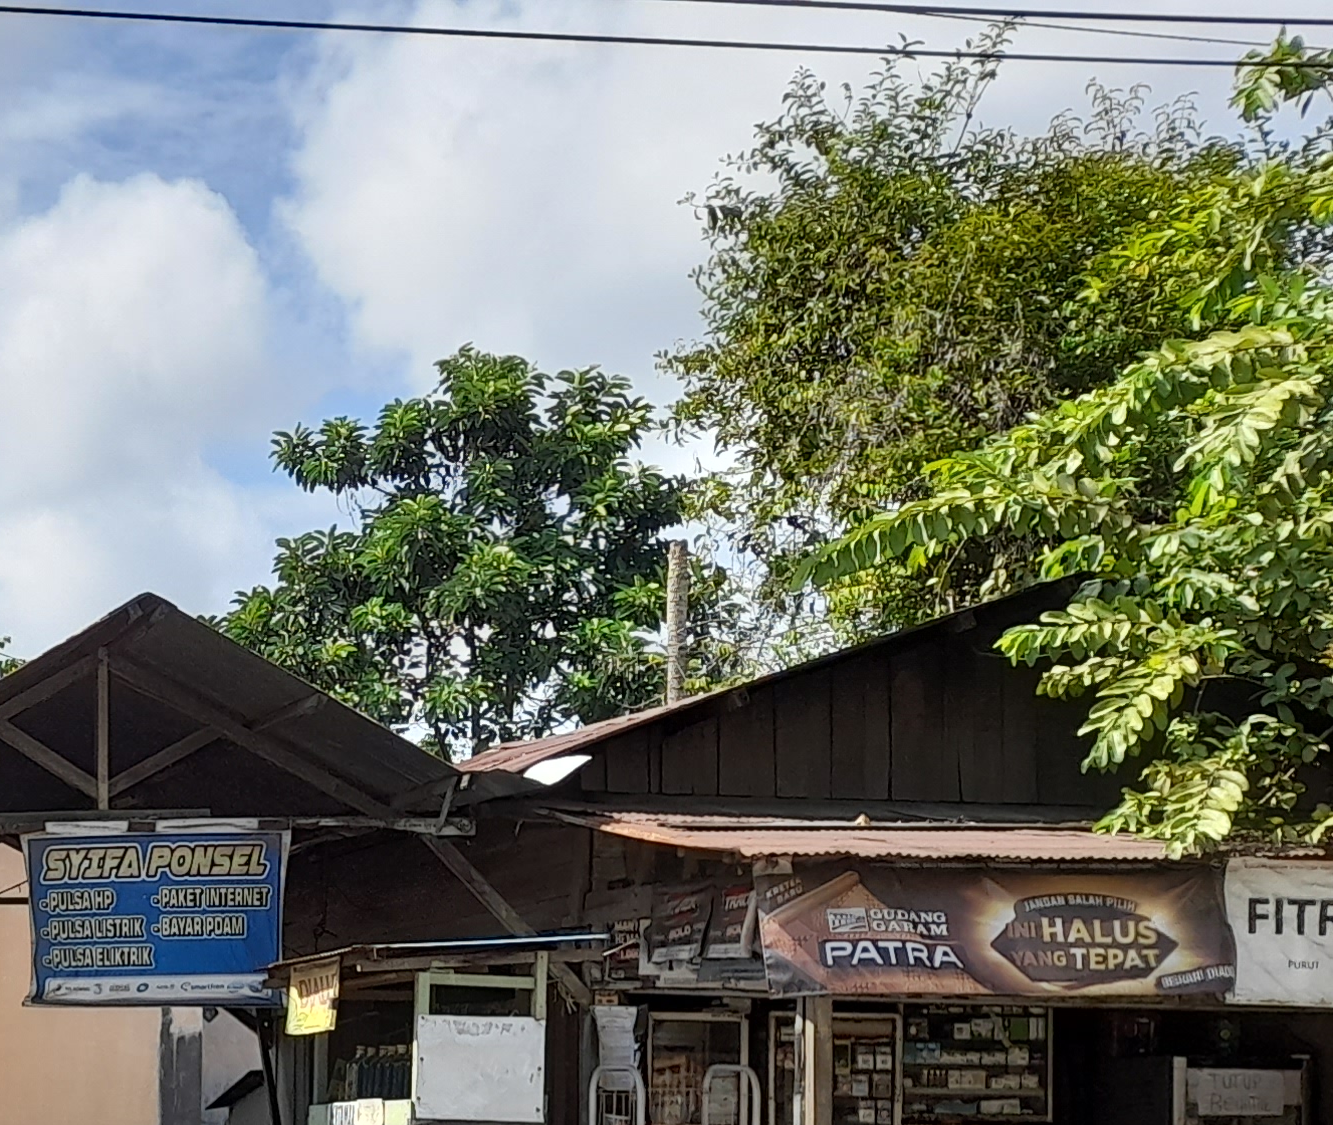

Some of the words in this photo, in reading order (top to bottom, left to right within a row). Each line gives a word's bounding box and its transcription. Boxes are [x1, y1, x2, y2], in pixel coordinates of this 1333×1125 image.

[43, 847, 141, 882] SYIFA
[145, 844, 268, 877] PONSEL
[49, 890, 94, 912] PULSA
[94, 889, 115, 909] HP
[161, 887, 202, 908] PAKET
[205, 886, 271, 906] INTERNET
[1023, 895, 1066, 913] JANGAN
[1067, 894, 1104, 906] SALAH
[1105, 896, 1137, 912] PILIH
[161, 916, 206, 937] BAYAR
[206, 916, 244, 936] PDAM
[869, 908, 947, 924] GUDANG
[50, 919, 95, 939] PULSA
[95, 917, 145, 937] LISTRIK
[872, 920, 950, 937] GARAM
[1006, 921, 1038, 939] INI
[1040, 916, 1159, 945] HALUS
[52, 947, 95, 968] PULSA
[95, 945, 153, 966] ELIKTRIK
[823, 940, 965, 970] PATRA
[1011, 950, 1068, 968] YANG
[1069, 947, 1161, 971] TEPAT
